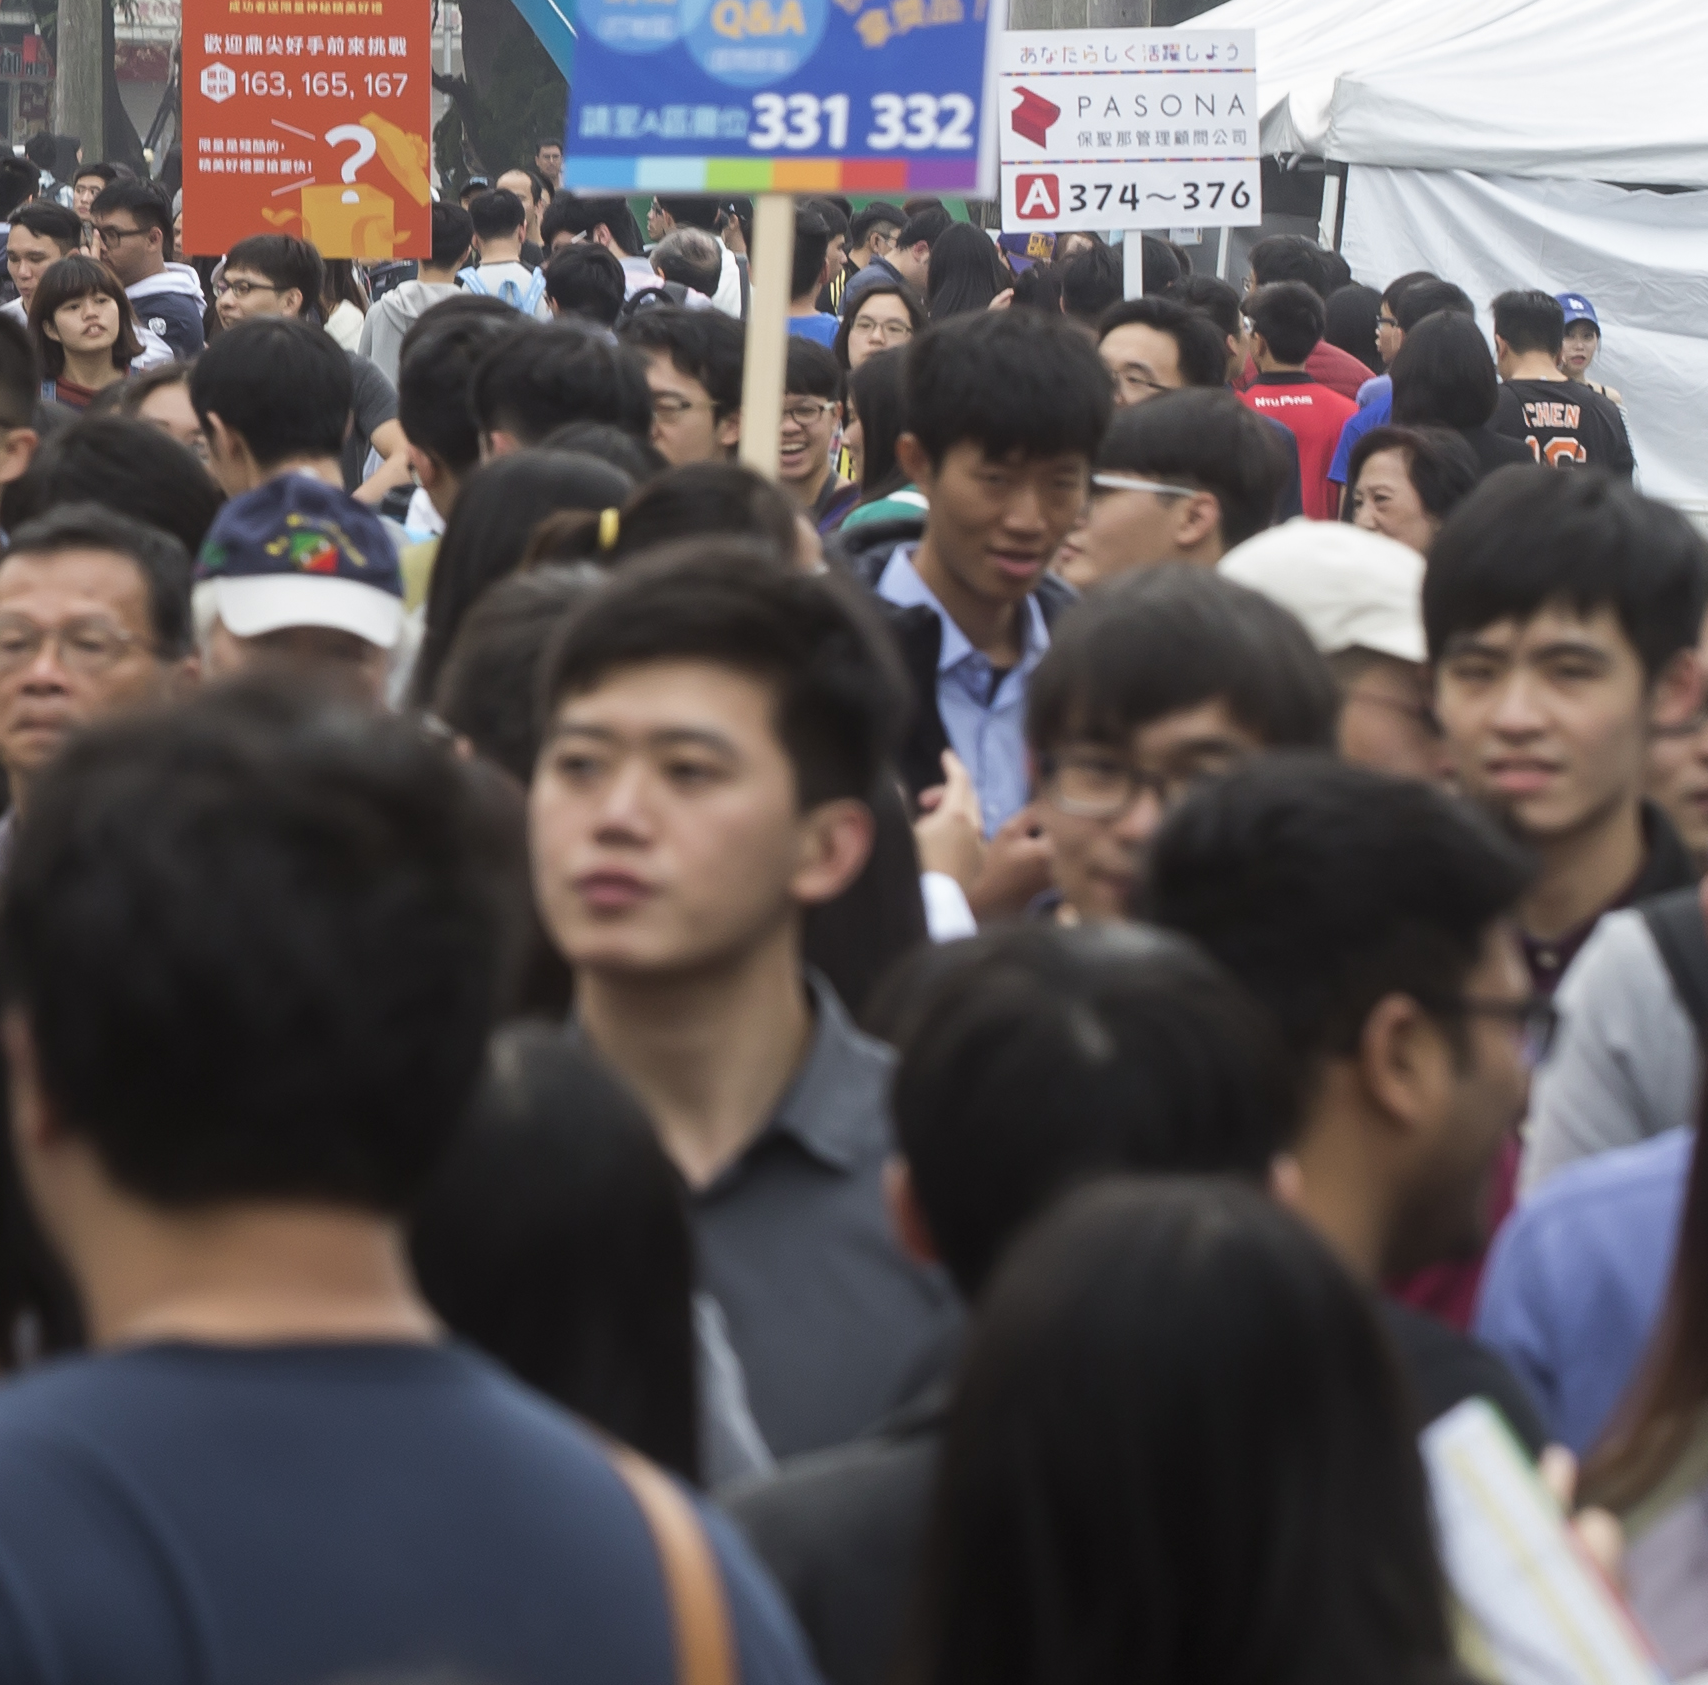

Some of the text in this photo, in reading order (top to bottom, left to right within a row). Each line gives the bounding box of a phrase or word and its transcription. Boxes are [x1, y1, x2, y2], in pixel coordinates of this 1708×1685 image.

[1020, 43, 1240, 64] あなたらしく活躍しよう
[364, 73, 409, 98] 167
[1077, 93, 1246, 118] PASONA
[747, 91, 851, 151] 331
[866, 91, 975, 151] 332
[1077, 128, 1248, 148] 保聖那管理顧問公司
[1019, 178, 1056, 215] A
